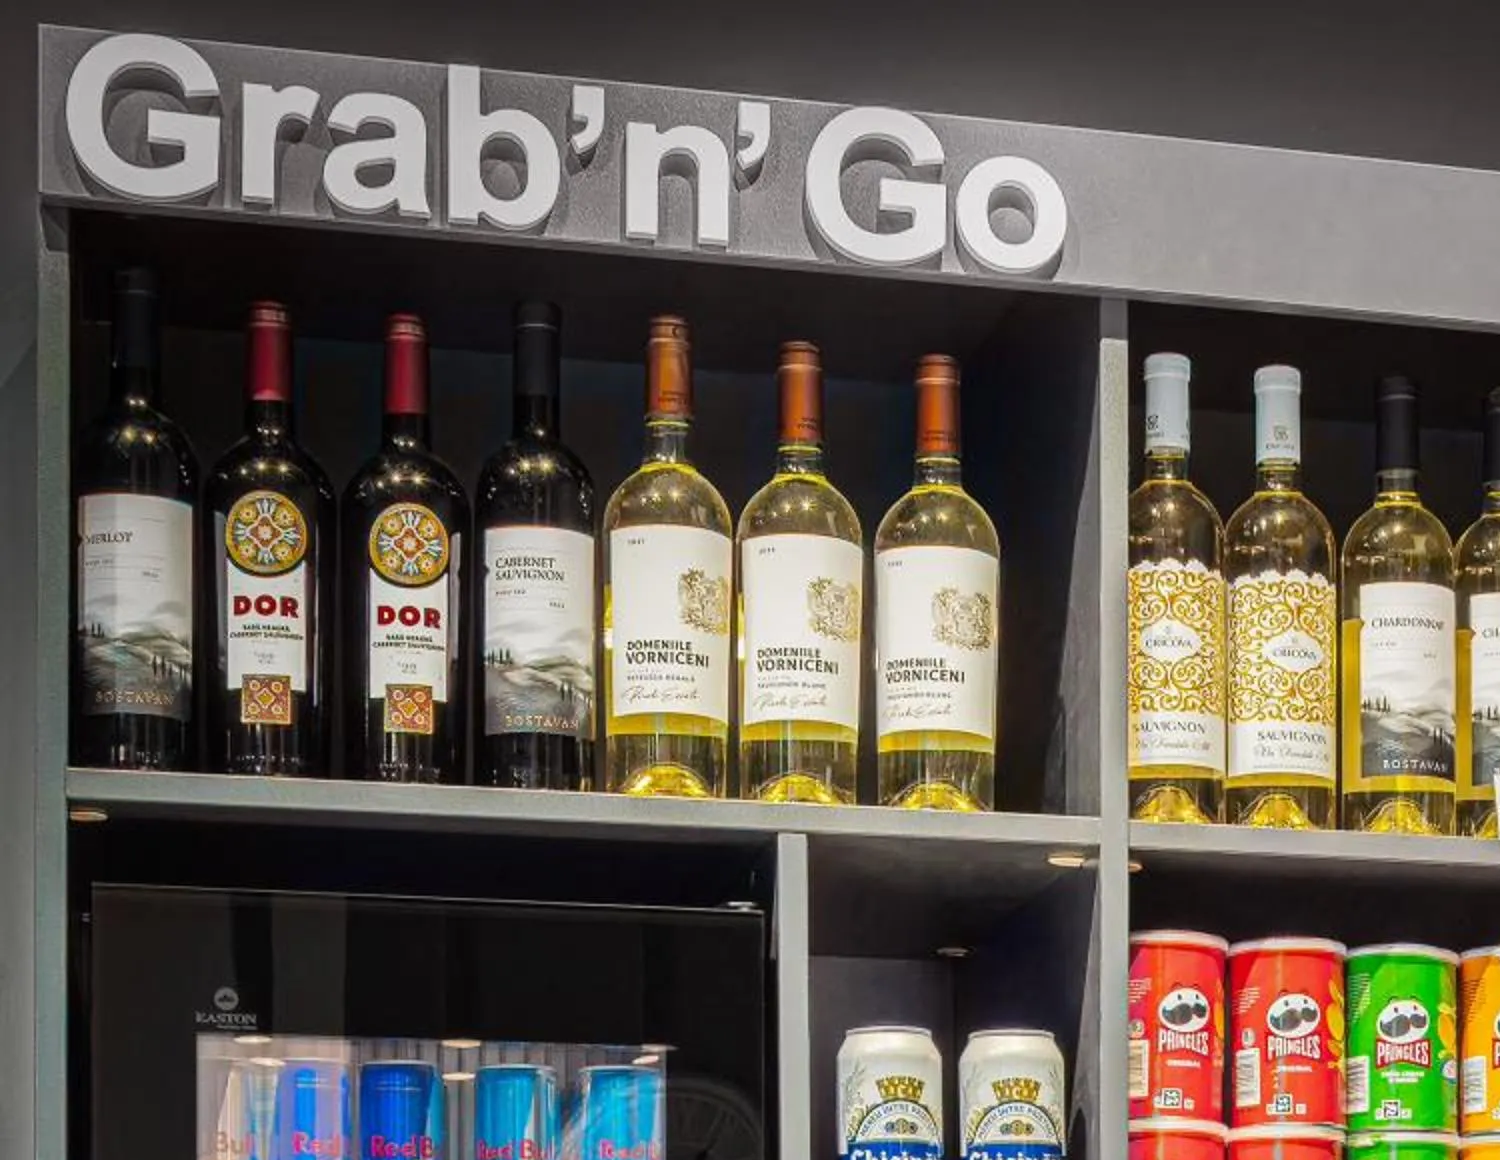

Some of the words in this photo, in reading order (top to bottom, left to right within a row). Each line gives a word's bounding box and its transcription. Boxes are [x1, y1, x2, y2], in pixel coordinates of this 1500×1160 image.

[495, 556, 556, 569] CABERNET
[495, 569, 565, 581] SAUVIGNON
[233, 595, 299, 618] DOR
[377, 606, 441, 629] DOR
[627, 640, 693, 652] DOMENIILE
[757, 647, 821, 659] DOMENIILE
[626, 651, 709, 668] VORNICENI
[756, 658, 839, 675] VORNICENI
[886, 668, 965, 684] VORNICENI
[1257, 731, 1327, 745] SAUVIGNON
[195, 1012, 257, 1025] EASTON
[1158, 1029, 1209, 1056] PRINGLES
[1267, 1034, 1321, 1060] PRINGLES
[1377, 1040, 1430, 1067] PRINGLES
[370, 1135, 418, 1159] Red
[477, 1140, 516, 1160] Red
